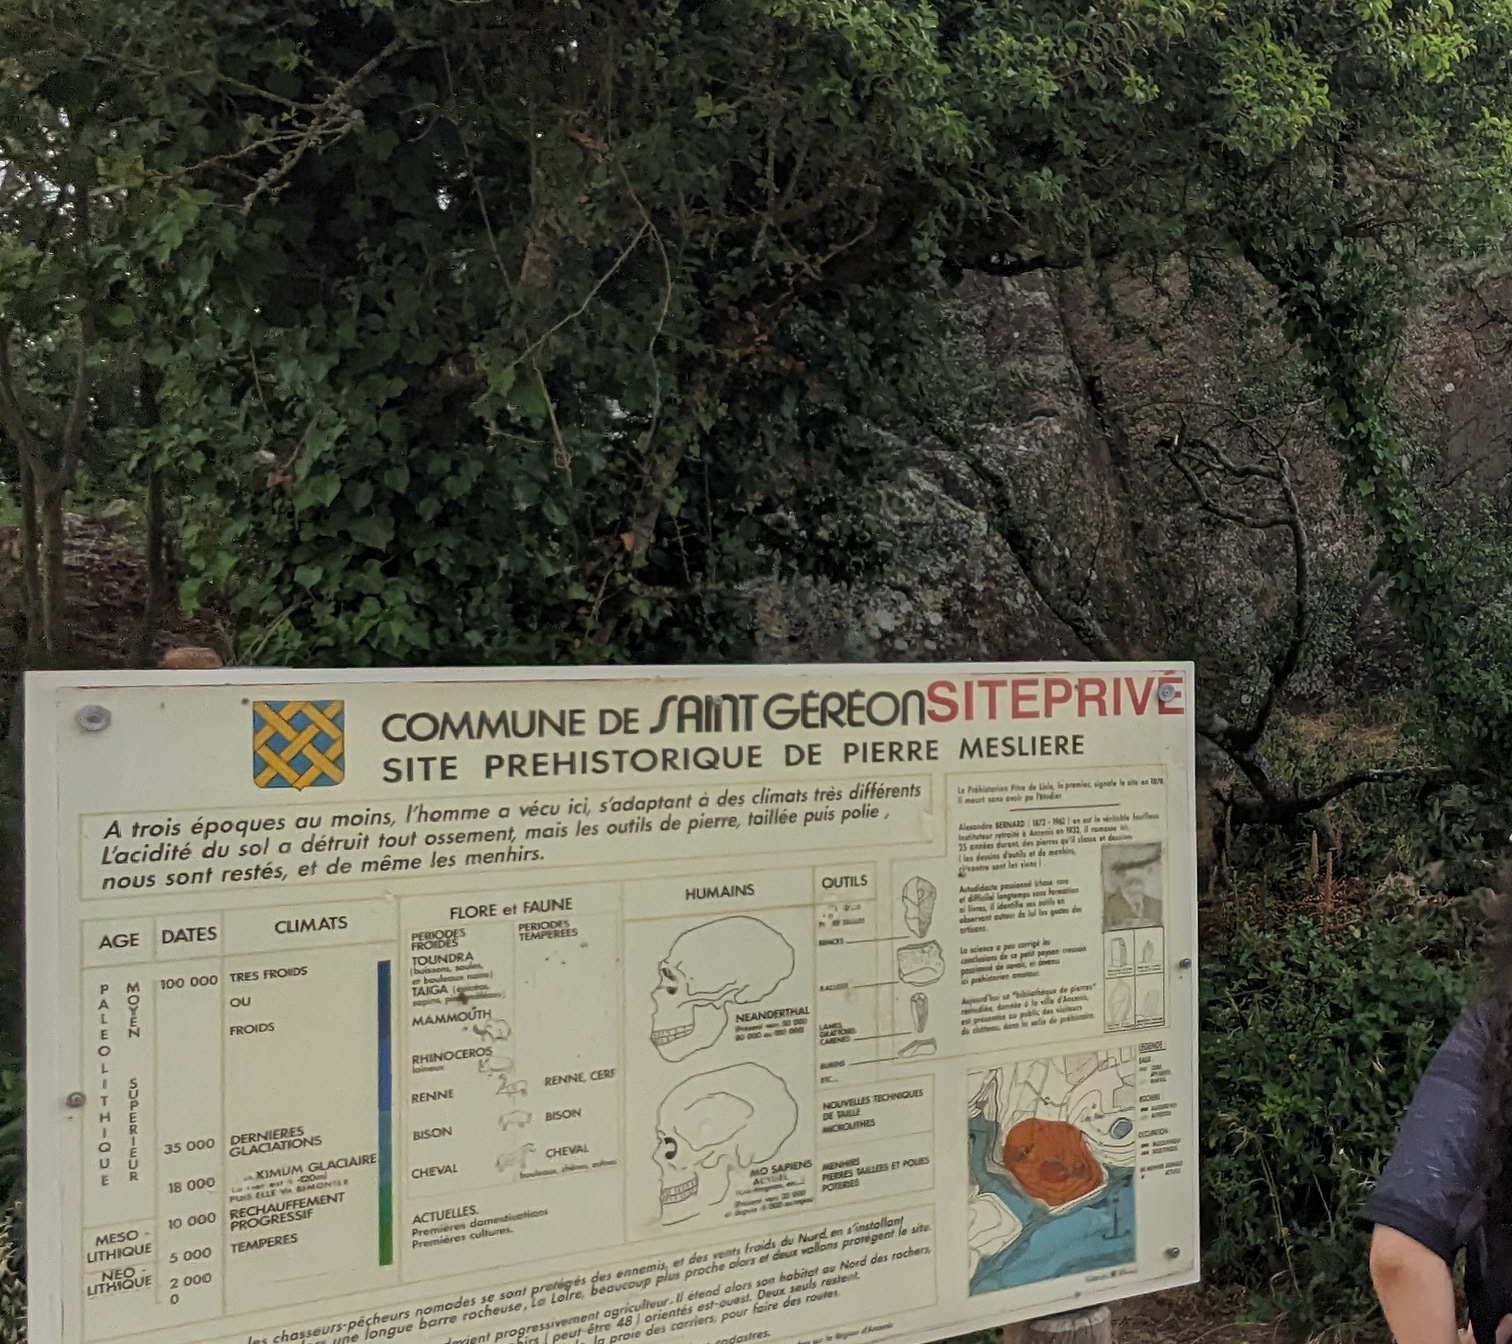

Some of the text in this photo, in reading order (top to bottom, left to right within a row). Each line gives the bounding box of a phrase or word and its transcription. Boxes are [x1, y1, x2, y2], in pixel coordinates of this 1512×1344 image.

[381, 708, 586, 742] COMMUNE
[599, 707, 639, 735] DE
[382, 735, 1084, 783] SITE PREHISTORIQUE DE PIERRE MESLIERE
[103, 782, 921, 839] A trois époques au moins, l'homme a vécu ici, s'adaptant à des climats très différents
[101, 842, 192, 866] L'acidité
[202, 839, 230, 859] du
[239, 837, 269, 857] sol
[278, 840, 291, 855] a
[300, 832, 371, 854] détruit
[378, 830, 417, 849] tout
[424, 825, 517, 846] ossement,
[525, 820, 568, 841] mais
[575, 817, 599, 837] les
[606, 814, 653, 836] outils
[660, 813, 681, 832] de
[687, 813, 740, 834] pierre,
[747, 806, 798, 827] taillée
[804, 807, 835, 828] puis
[101, 845, 545, 891] nous sont restés, et de même les menhirs.
[822, 874, 868, 889] OUTILS
[685, 884, 755, 901] HUMAINS
[450, 897, 573, 920] FLORE et FAUNE
[274, 916, 348, 935] CLIMATS
[518, 920, 570, 932] PERIODES
[98, 933, 140, 950] AGE
[161, 926, 217, 945] DATES
[411, 928, 466, 942] PERIODES
[519, 928, 578, 942] TEMPEREES
[411, 939, 459, 951] FROIDES
[412, 951, 474, 966] TOUNDRA
[160, 974, 218, 990] 100 000
[230, 966, 308, 983] TRES FROIDS
[230, 996, 251, 1008] OU
[229, 1022, 275, 1036] FROIDS
[412, 1046, 493, 1065] RHINOCEROS
[411, 1089, 454, 1104] RENNE
[545, 1108, 582, 1122] BISON
[230, 1126, 304, 1146] DERNIERES
[413, 1126, 452, 1141] BISON
[163, 1138, 215, 1155] 35 000
[229, 1136, 322, 1157] GLACIATIONS
[545, 1144, 589, 1159] CHEVAL
[307, 1153, 377, 1173] GLACIAIRE
[411, 1164, 458, 1180] CHEVAL
[168, 1181, 182, 1194] 18
[187, 1176, 215, 1191] 000
[229, 1192, 346, 1220] RECHAUFFEMENT
[168, 1212, 216, 1230] 10 000
[230, 1208, 314, 1232] PROGRESSIF
[230, 1233, 298, 1254] TEMPERES
[86, 1243, 152, 1264] LITHIQUE
[169, 1247, 212, 1263] 5 000
[86, 1275, 152, 1297] LITHIQUE
[169, 1272, 213, 1290] 2 000
